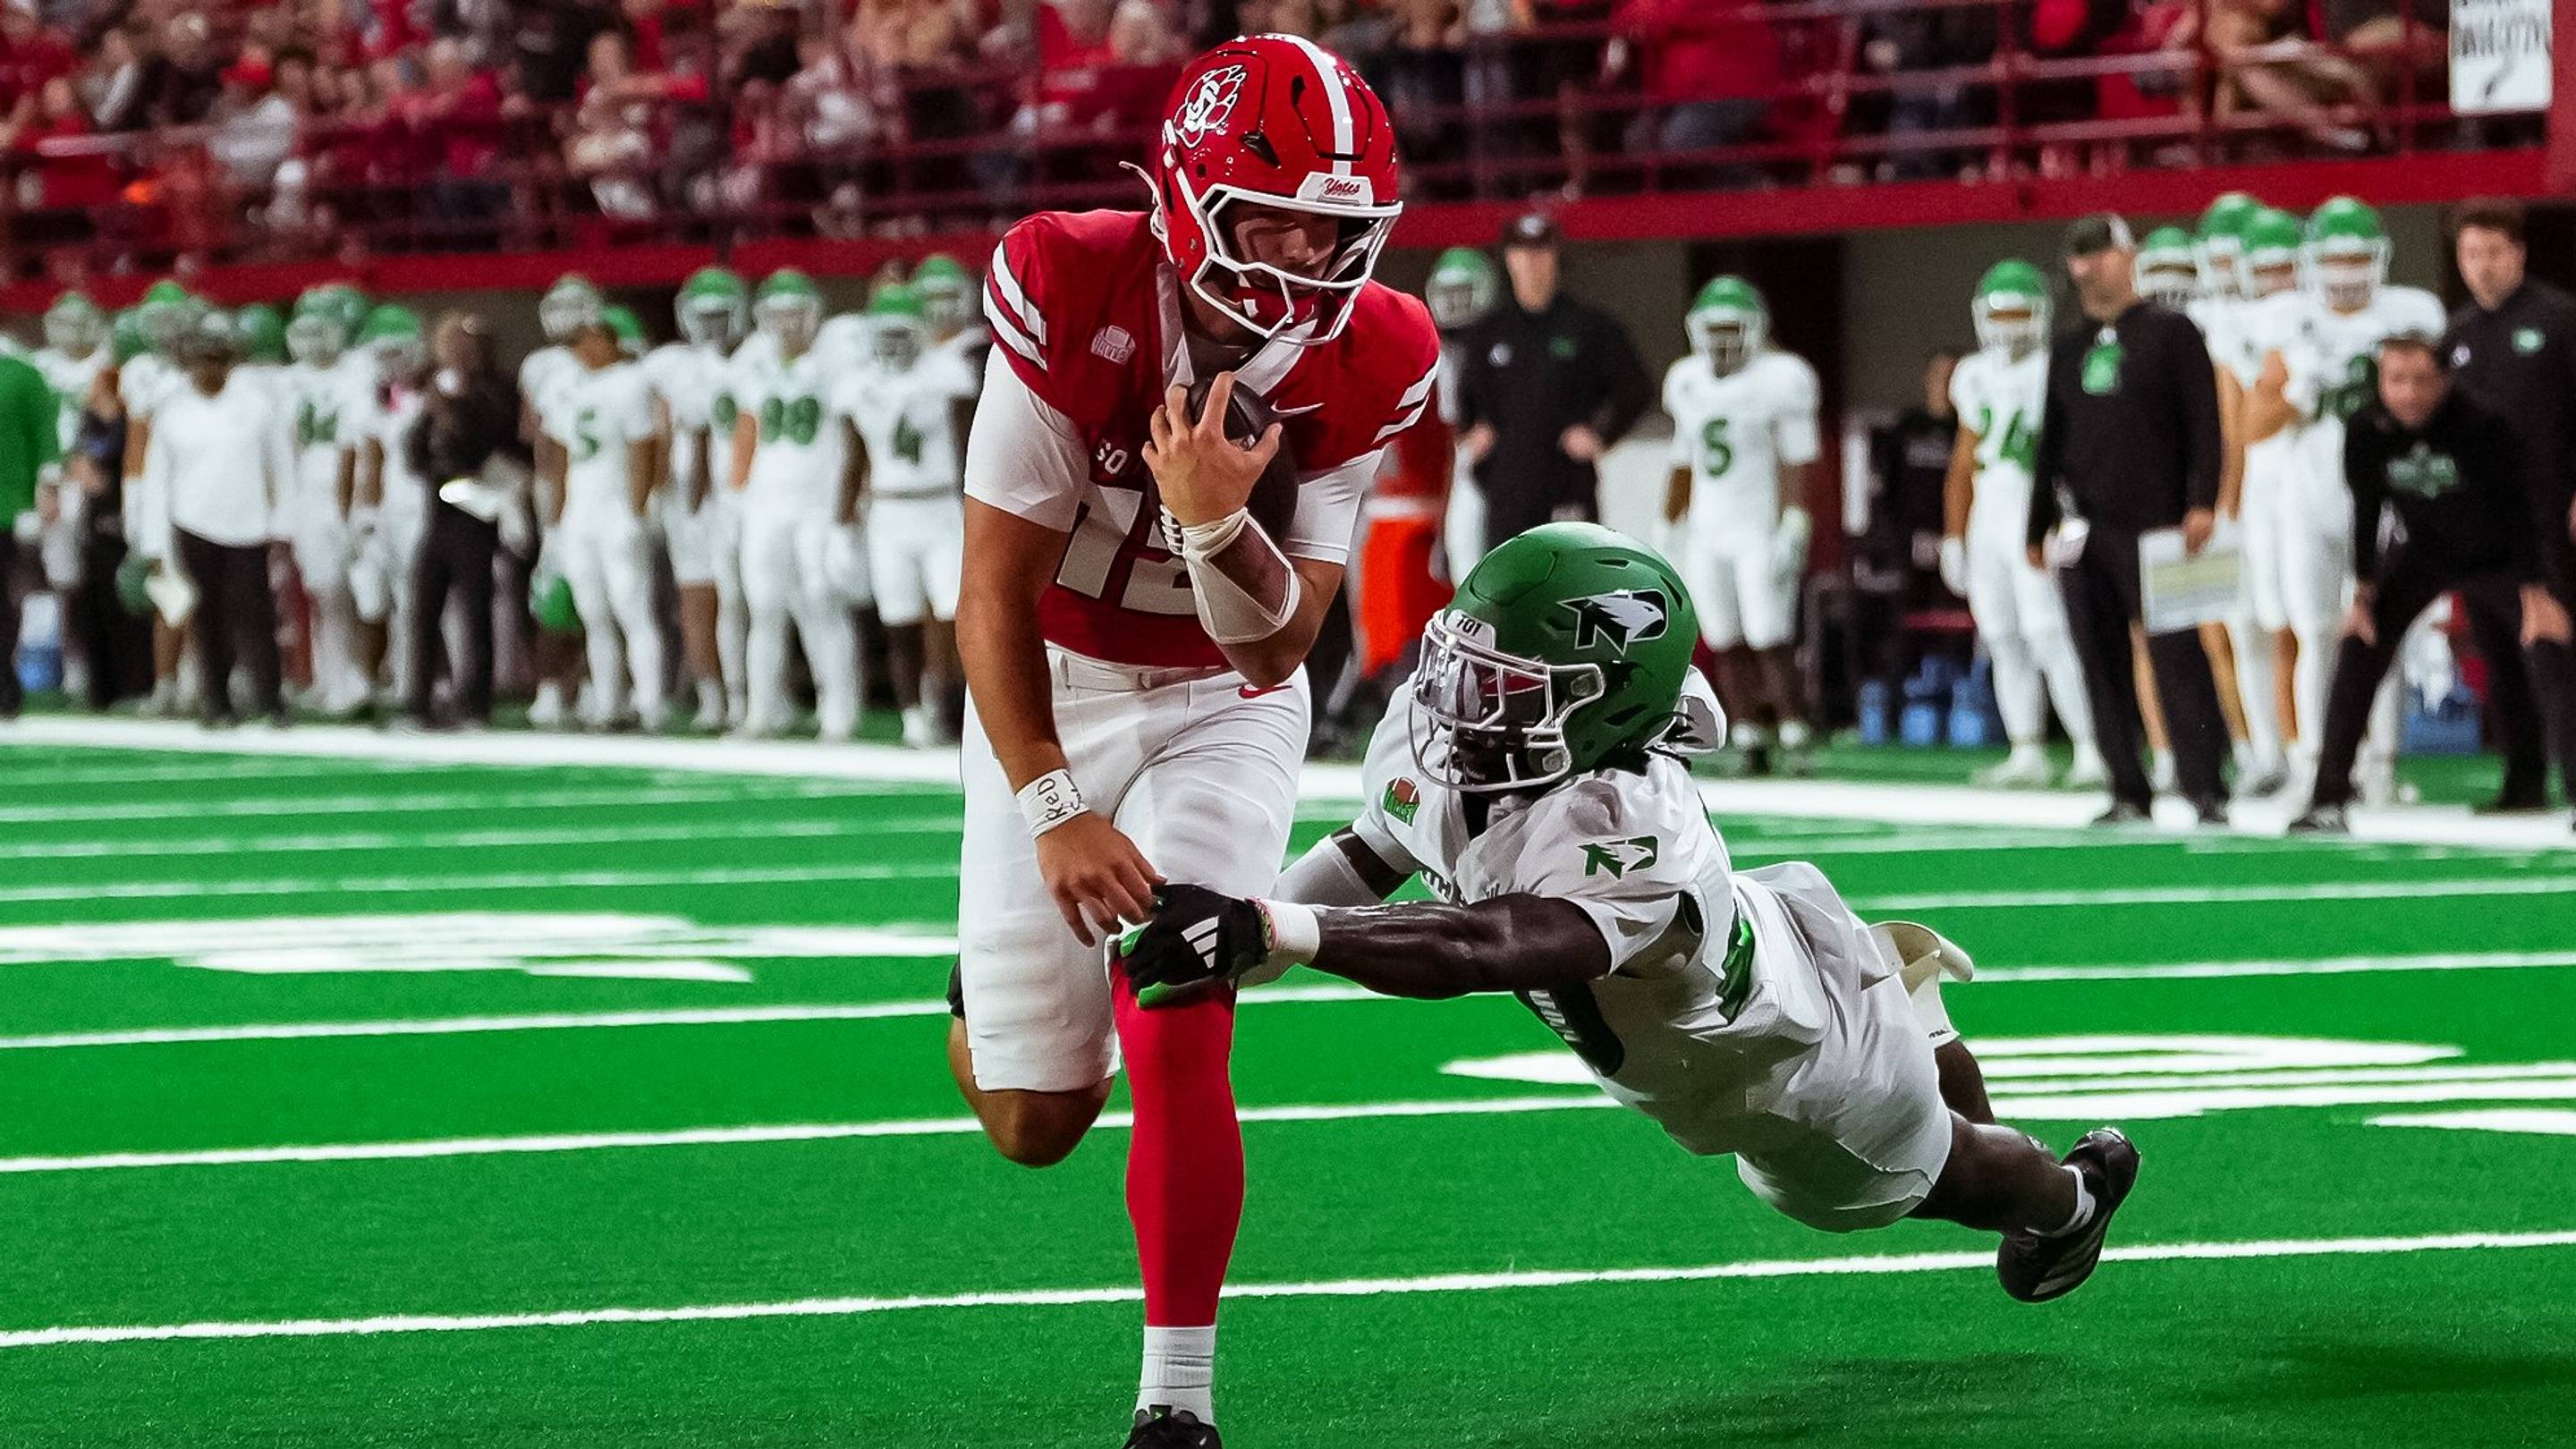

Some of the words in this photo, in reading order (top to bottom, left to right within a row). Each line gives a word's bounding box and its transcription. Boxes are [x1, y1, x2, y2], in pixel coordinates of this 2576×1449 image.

[1324, 177, 1360, 196] Yotes
[893, 412, 926, 466] 4
[1702, 417, 1733, 478] 5
